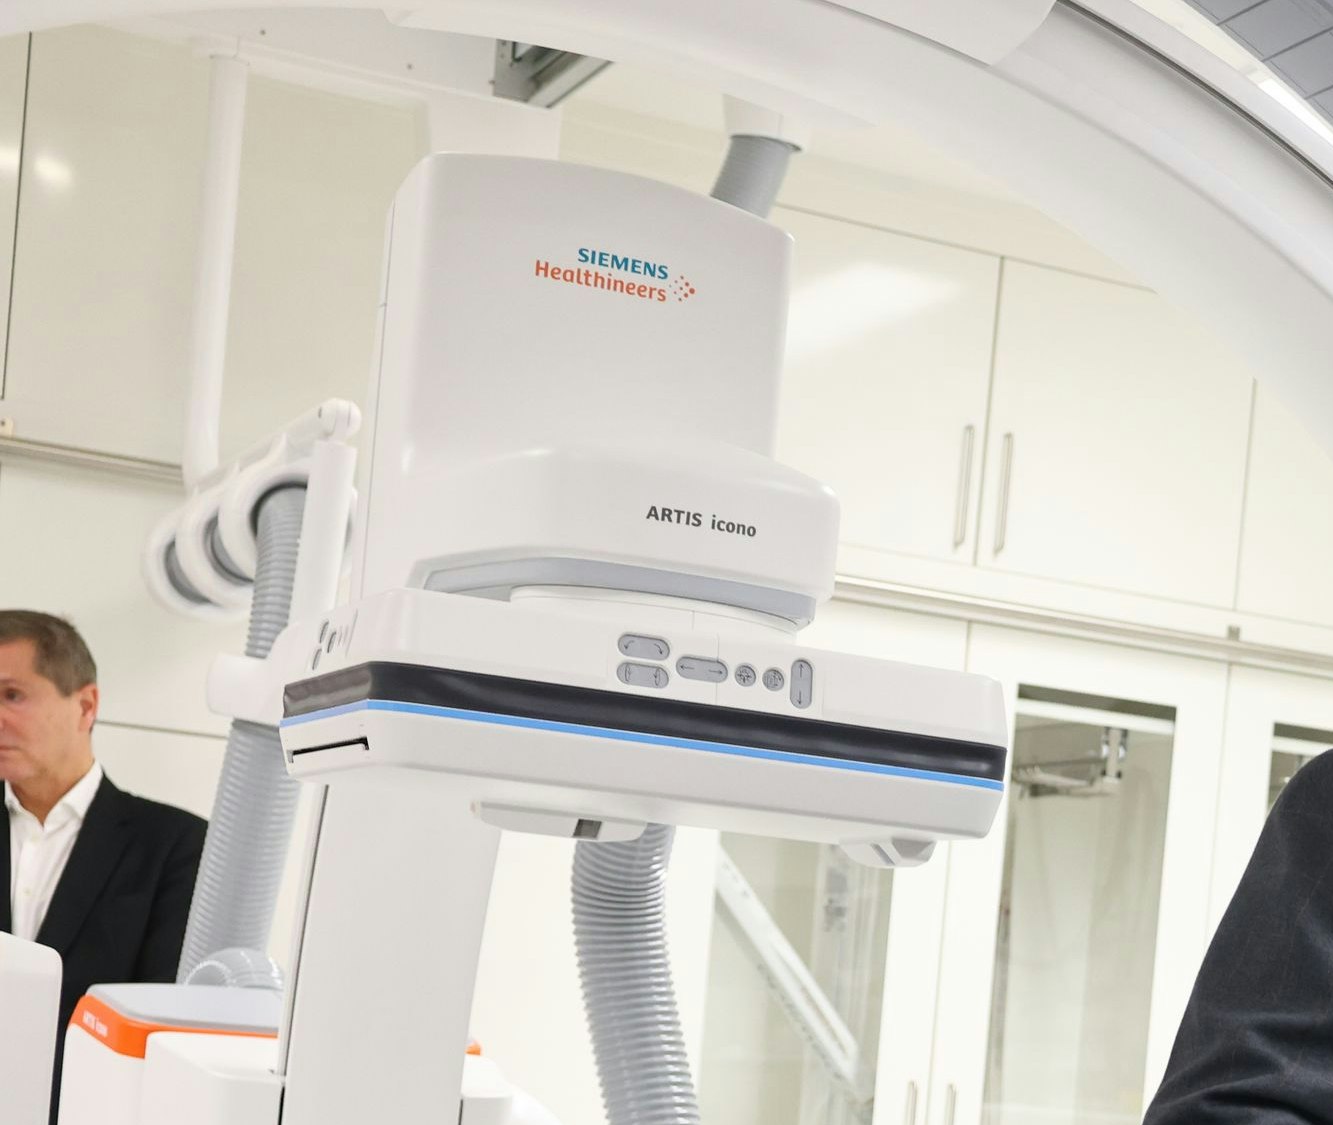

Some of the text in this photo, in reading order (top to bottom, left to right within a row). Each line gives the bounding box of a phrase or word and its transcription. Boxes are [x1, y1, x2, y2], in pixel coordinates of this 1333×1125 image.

[578, 248, 669, 280] SIEMENS
[535, 260, 666, 302] Healthineers
[646, 505, 757, 537] ARTIS icono
